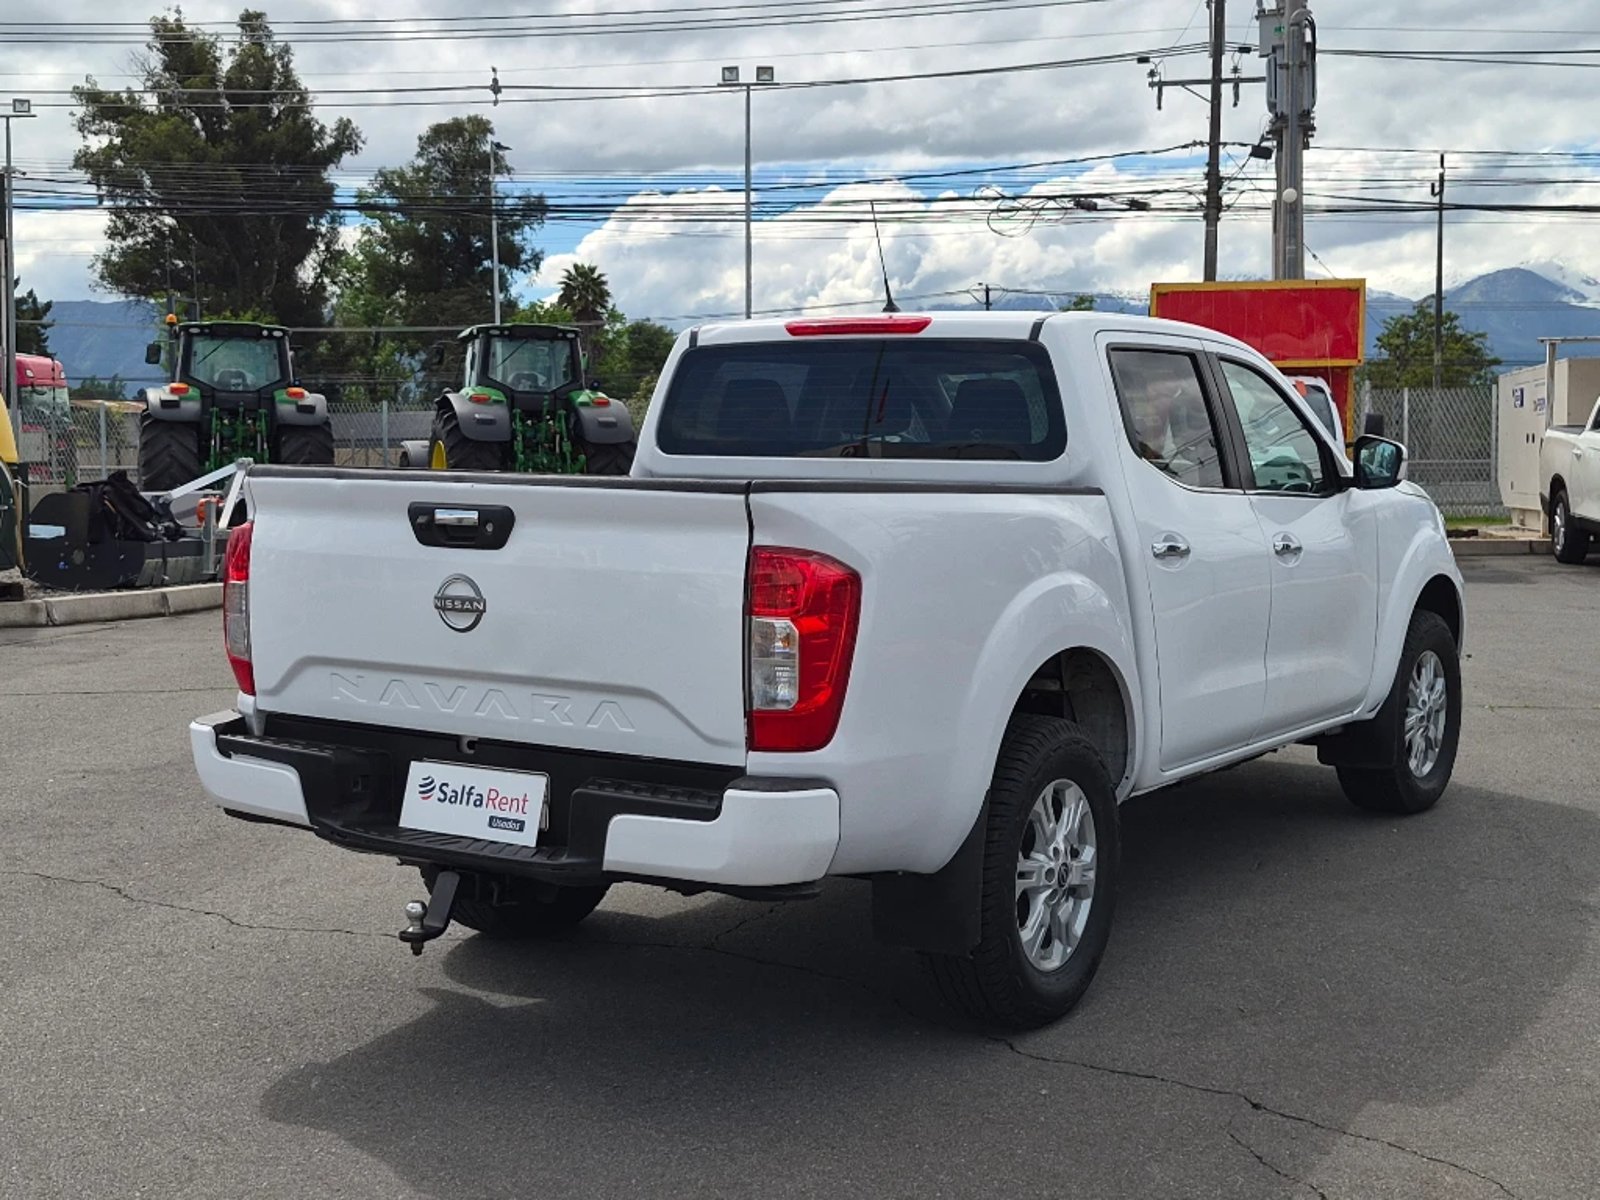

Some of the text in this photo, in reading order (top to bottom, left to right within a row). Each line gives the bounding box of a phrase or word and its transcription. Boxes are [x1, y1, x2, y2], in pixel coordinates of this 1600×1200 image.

[435, 599, 484, 610] NISSAN
[330, 672, 636, 732] NAVARA
[437, 782, 529, 815] SalfaRent
[491, 817, 521, 831] Usados
